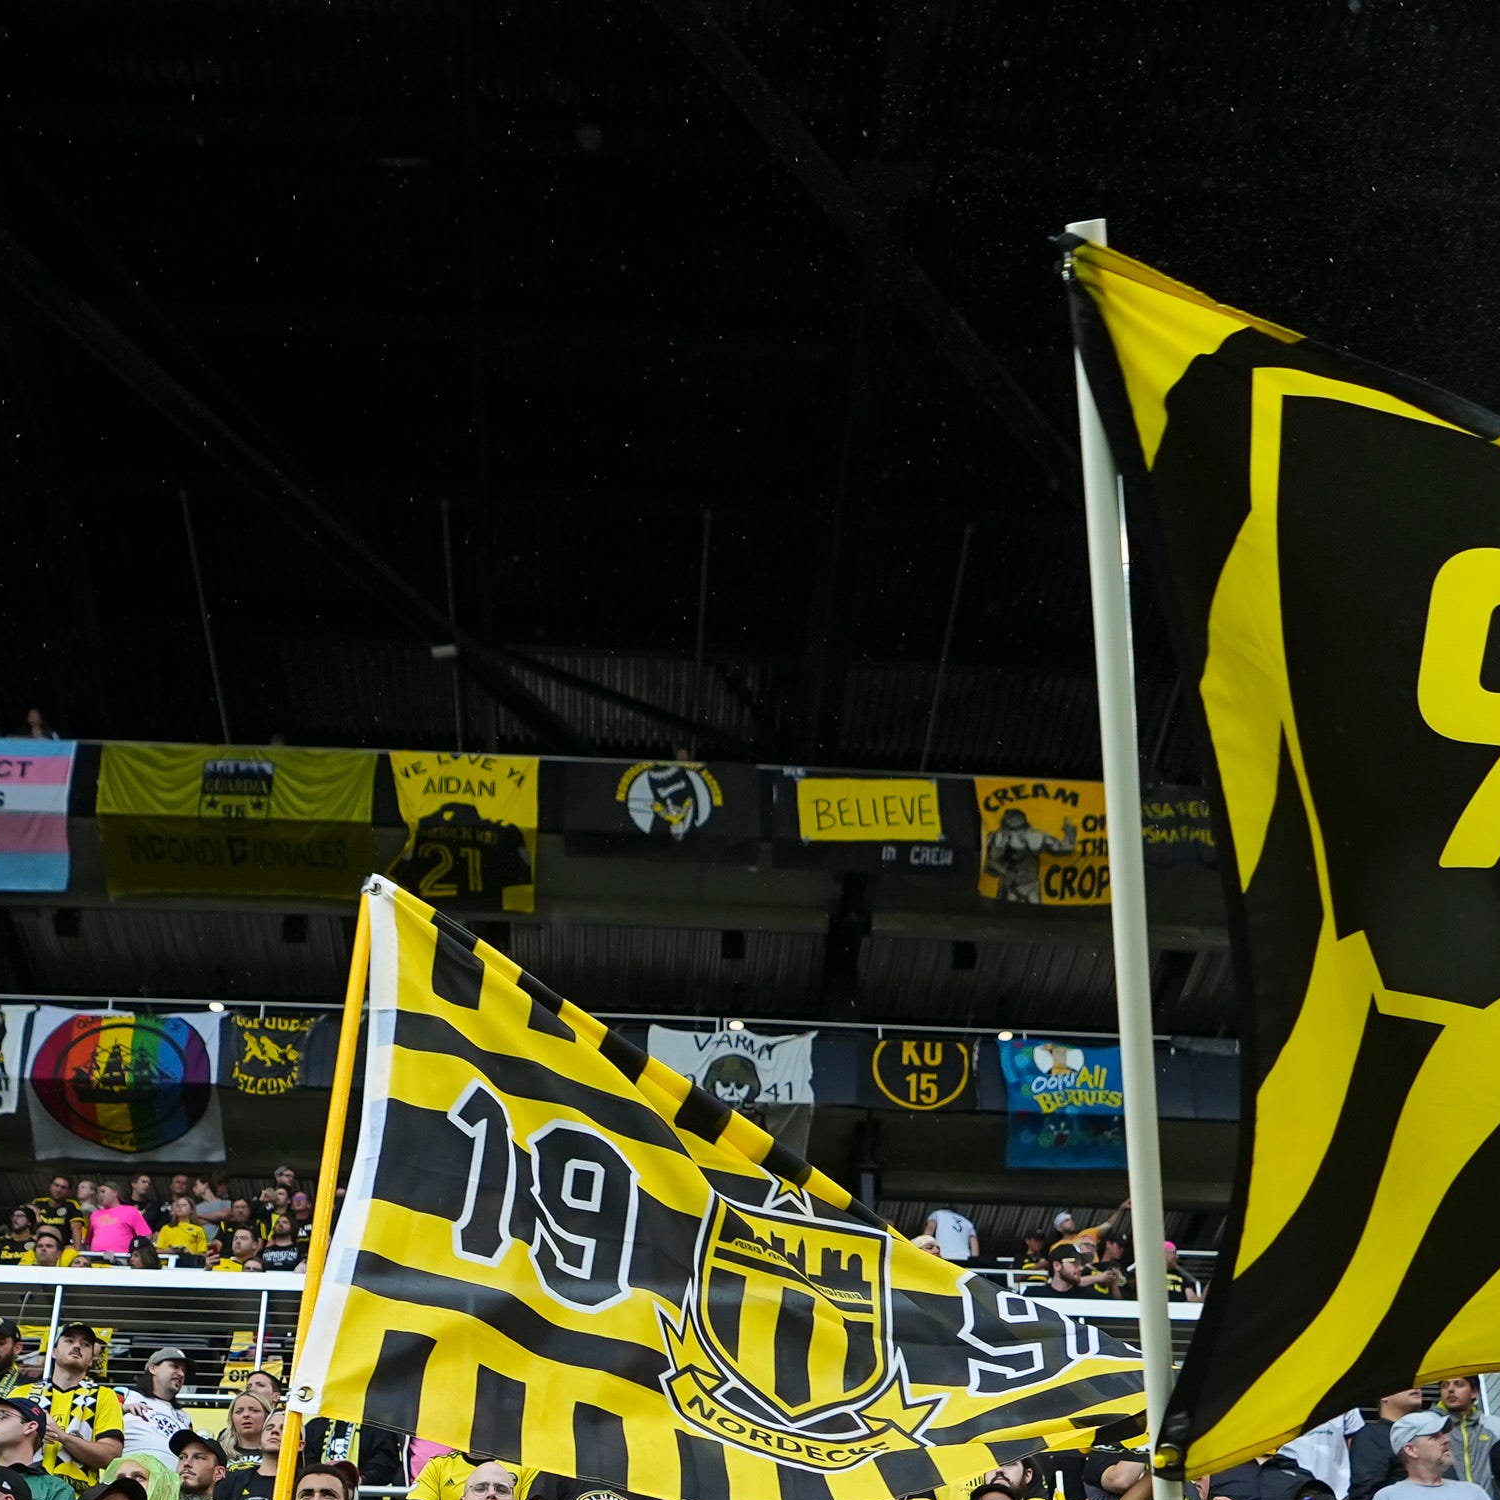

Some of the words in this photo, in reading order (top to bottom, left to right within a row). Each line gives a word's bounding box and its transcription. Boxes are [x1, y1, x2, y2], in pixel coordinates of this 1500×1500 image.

[204, 778, 270, 794] GUARDIA
[421, 775, 496, 797] AIDAN
[982, 783, 1080, 812] CREAM
[812, 793, 936, 831] BELIEVE
[418, 841, 484, 898] 21
[909, 845, 955, 866] CREW
[1043, 864, 1110, 900] CROP
[901, 1039, 944, 1067] KU
[764, 1081, 794, 1102] 41
[904, 1071, 939, 1105] 15
[1032, 1088, 1125, 1115] BERRIES
[446, 1076, 641, 1316] 19
[685, 1394, 893, 1464] NORDECKE
